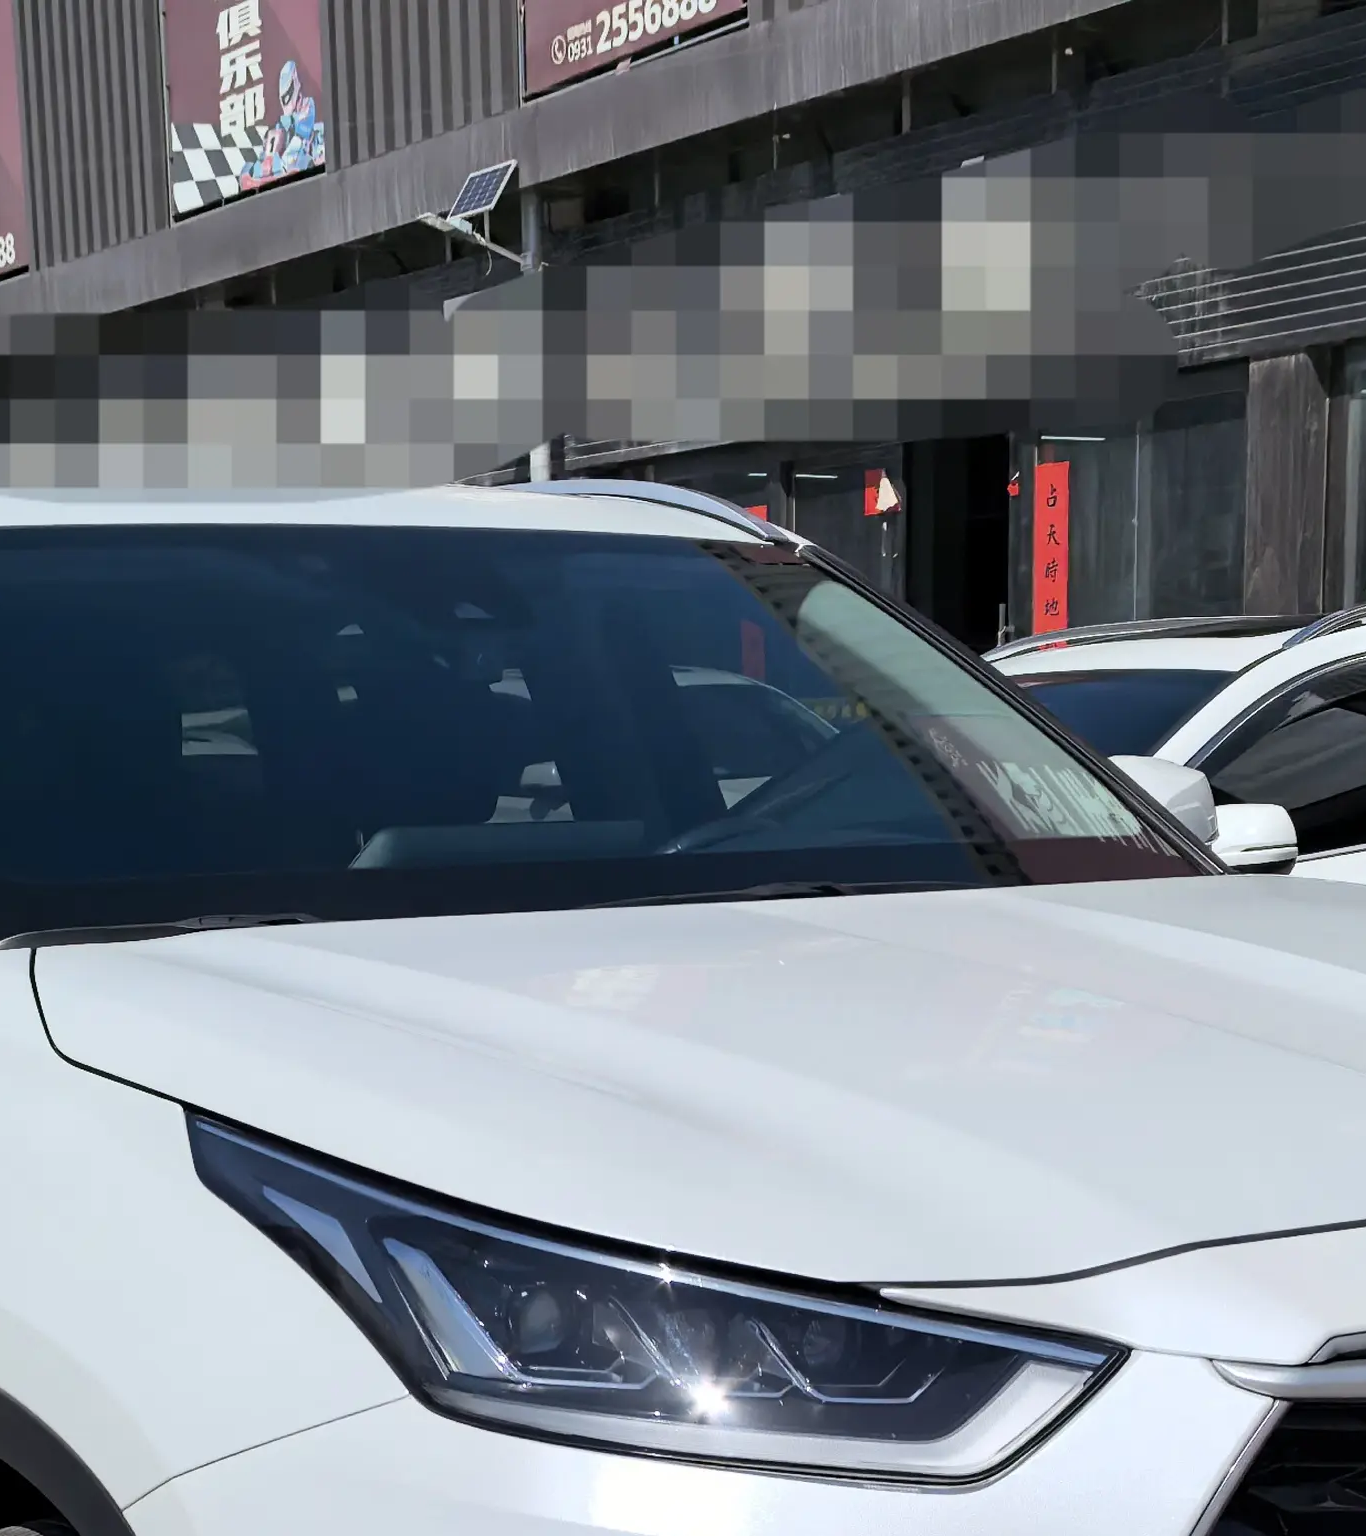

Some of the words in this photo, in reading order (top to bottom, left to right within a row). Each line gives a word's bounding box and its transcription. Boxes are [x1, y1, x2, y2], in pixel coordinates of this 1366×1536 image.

[216, 0, 265, 138] 俱乐部
[567, 37, 594, 62] 0931
[1044, 484, 1061, 648] 占天時地
